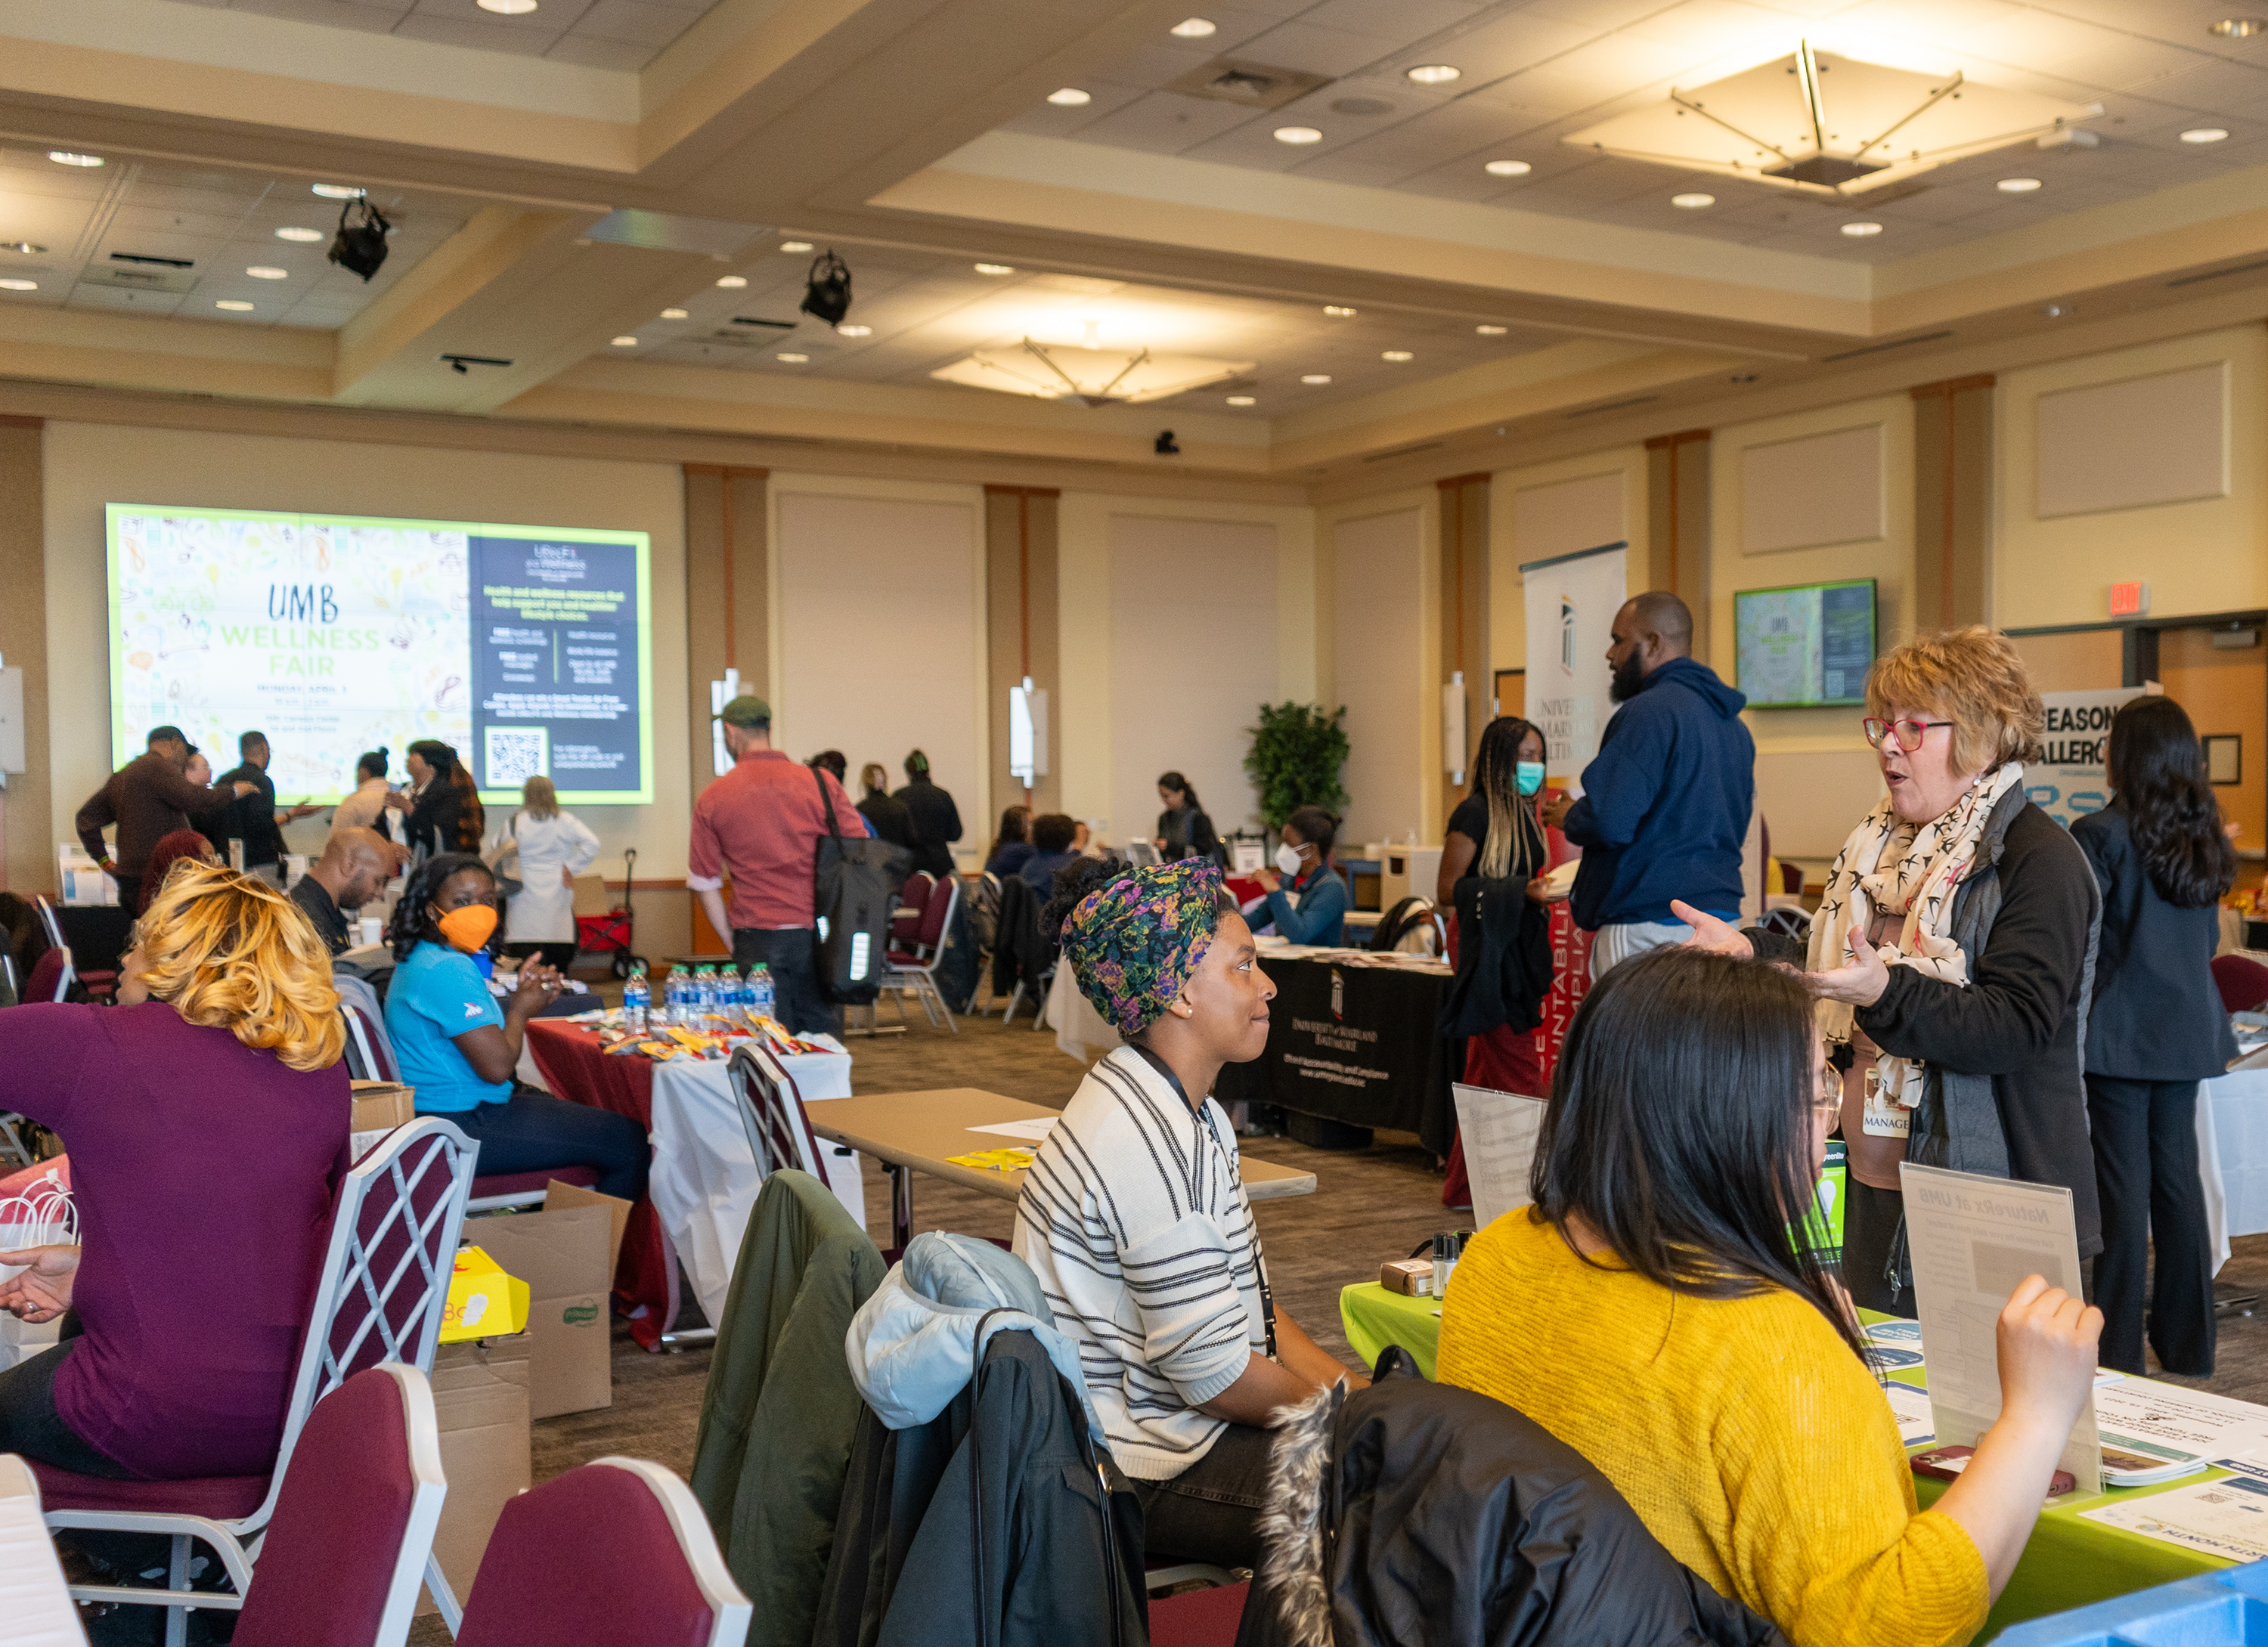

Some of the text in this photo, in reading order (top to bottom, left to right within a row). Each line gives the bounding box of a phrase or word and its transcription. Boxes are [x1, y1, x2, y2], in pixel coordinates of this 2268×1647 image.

[268, 584, 339, 624] UMB
[220, 626, 380, 651] WELLNESS
[269, 655, 335, 676] FAIR
[2041, 706, 2118, 732] EASON
[1864, 1116, 1910, 1130] MANAGE
